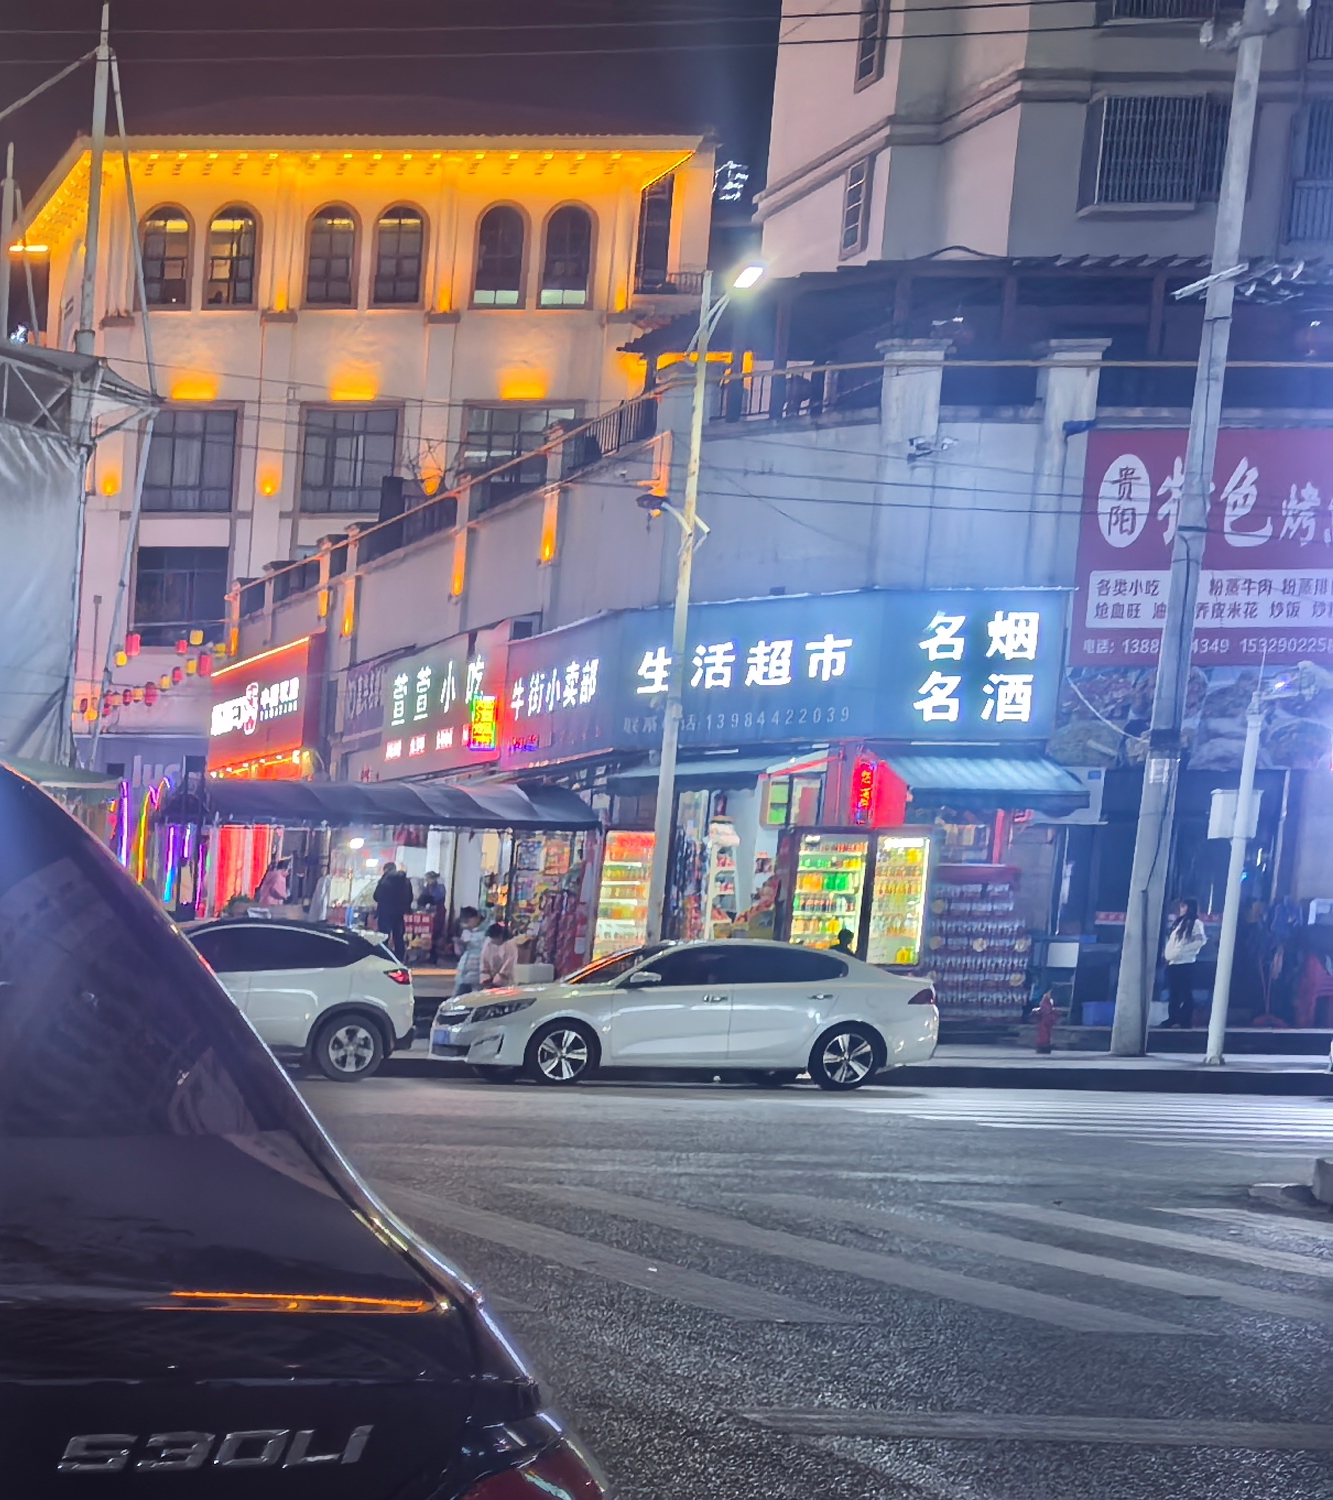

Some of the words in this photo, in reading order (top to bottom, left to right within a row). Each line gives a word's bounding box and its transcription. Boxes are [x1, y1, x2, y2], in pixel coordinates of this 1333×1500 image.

[1108, 466, 1141, 537] 贵阳
[1269, 601, 1300, 619] 炒饭
[1311, 601, 1333, 618] 炒
[1282, 577, 1333, 596] 粉蒸排
[918, 610, 1040, 661] 名烟
[510, 657, 601, 722] 牛街小卖部
[636, 633, 853, 695] 生活超市
[913, 671, 1035, 724] 名酒
